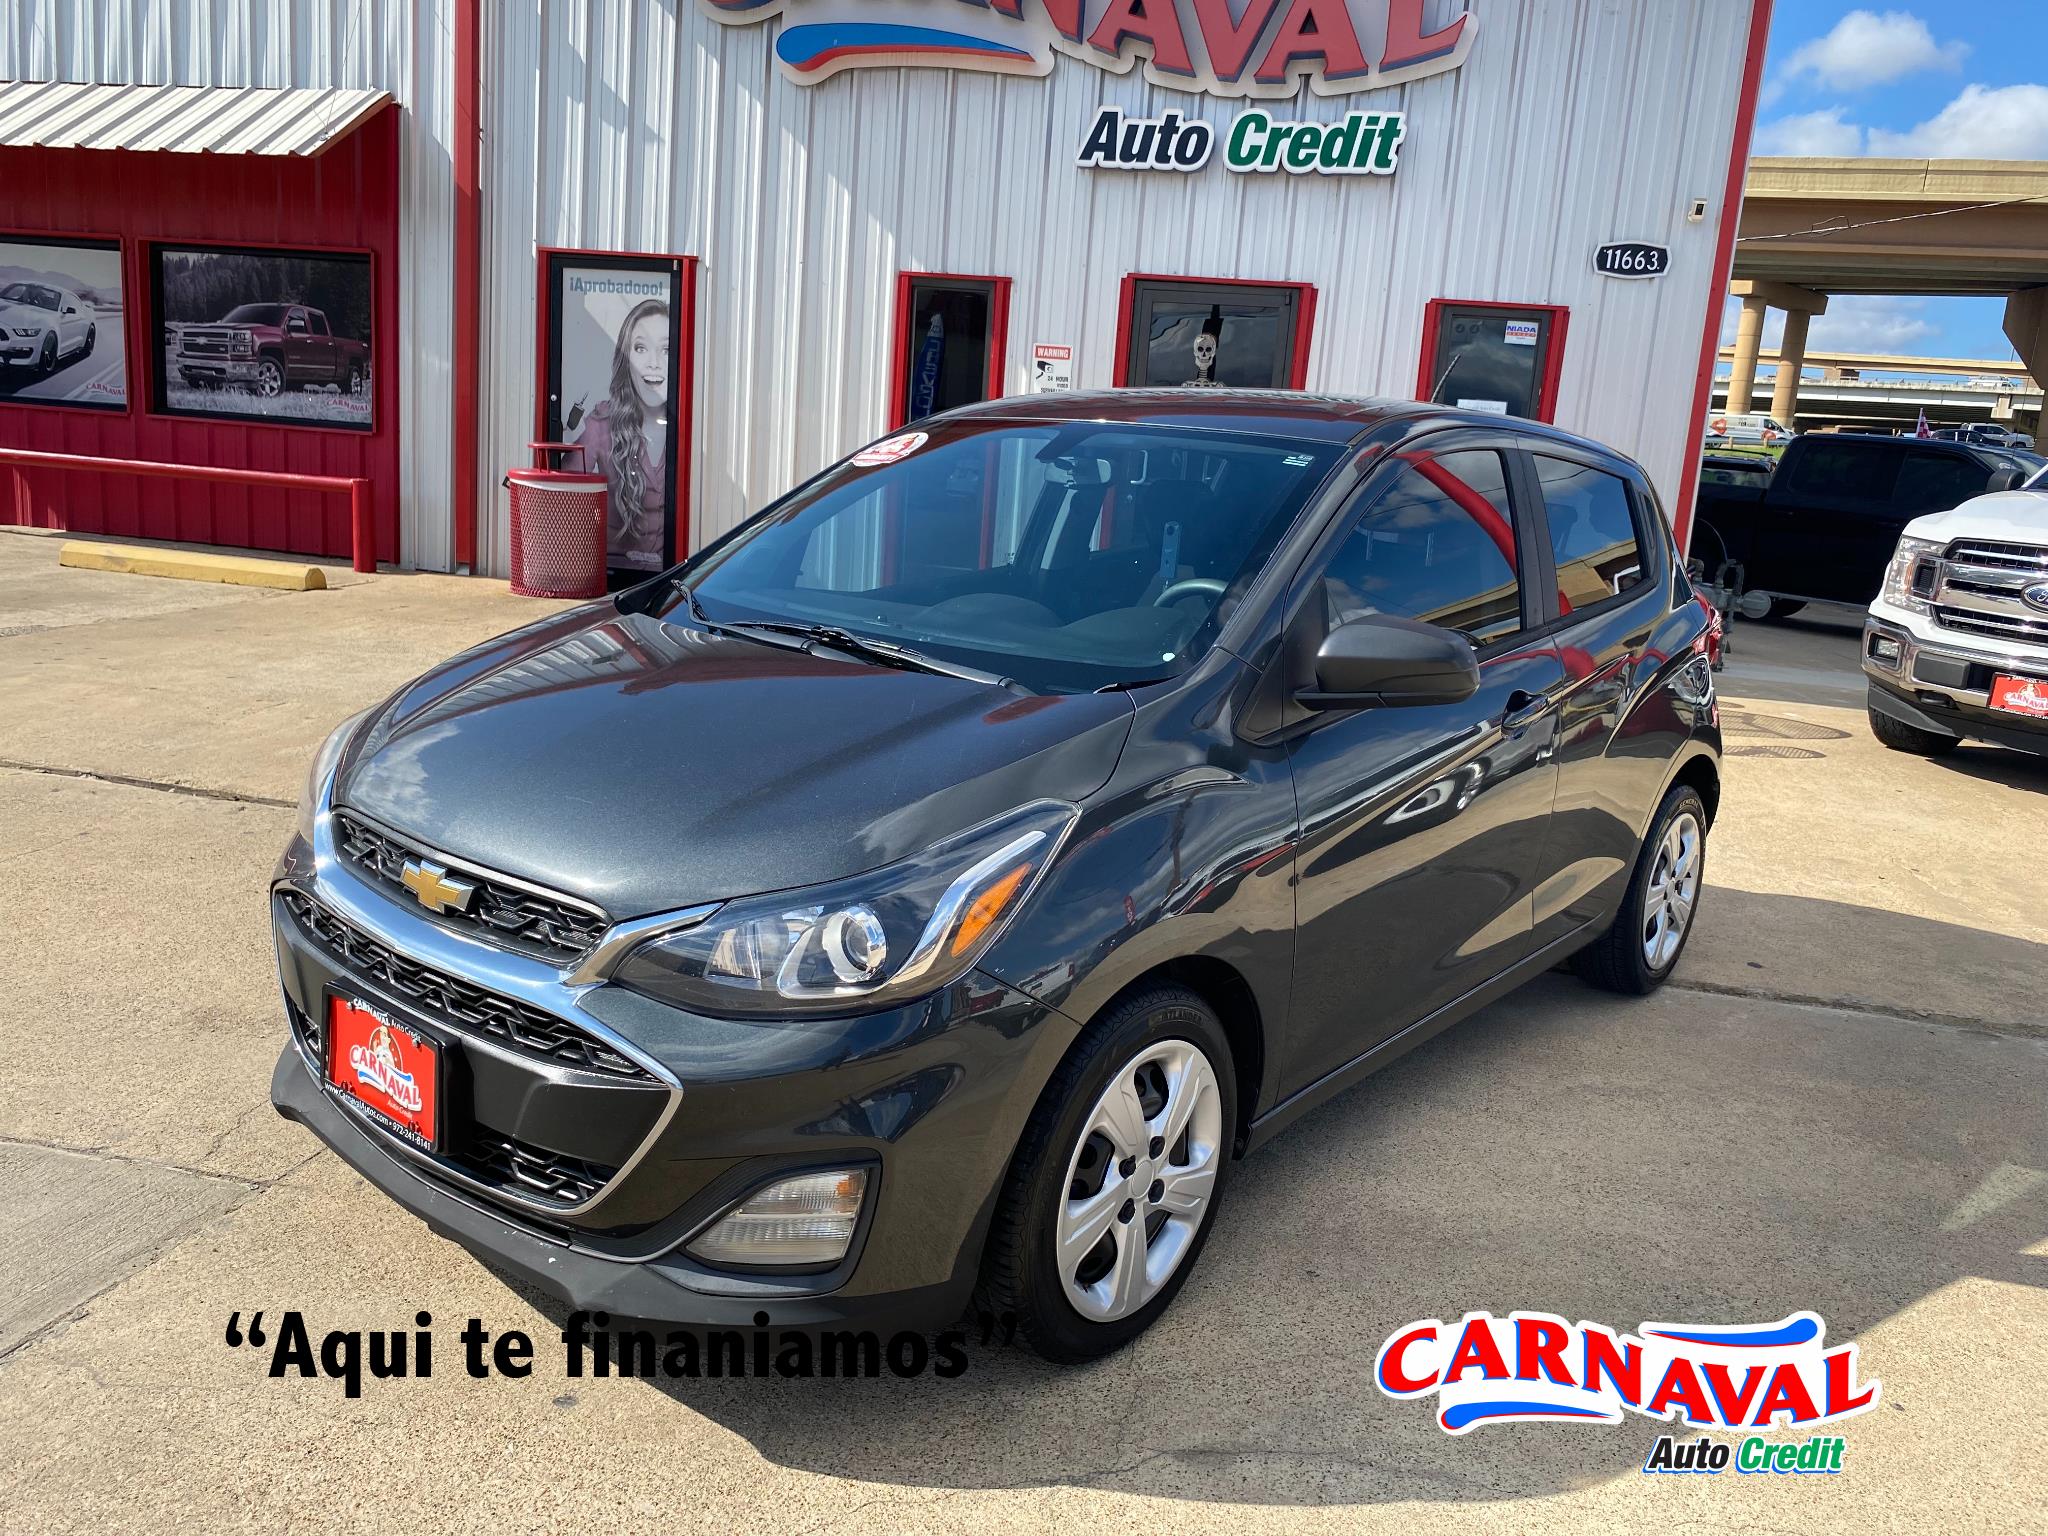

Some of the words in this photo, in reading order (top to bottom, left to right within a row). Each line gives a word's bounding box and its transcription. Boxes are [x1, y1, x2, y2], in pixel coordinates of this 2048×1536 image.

[1077, 111, 1210, 165] Auto
[1227, 113, 1402, 169] Credit
[1605, 248, 1659, 271] 11663
[569, 276, 664, 297] ¡Aprobadooo!
[1037, 347, 1069, 359] WARNING
[353, 997, 391, 1027] CARNAVAL
[350, 1045, 421, 1107] CARNAVAL
[392, 1121, 431, 1151] 972-241-8141
